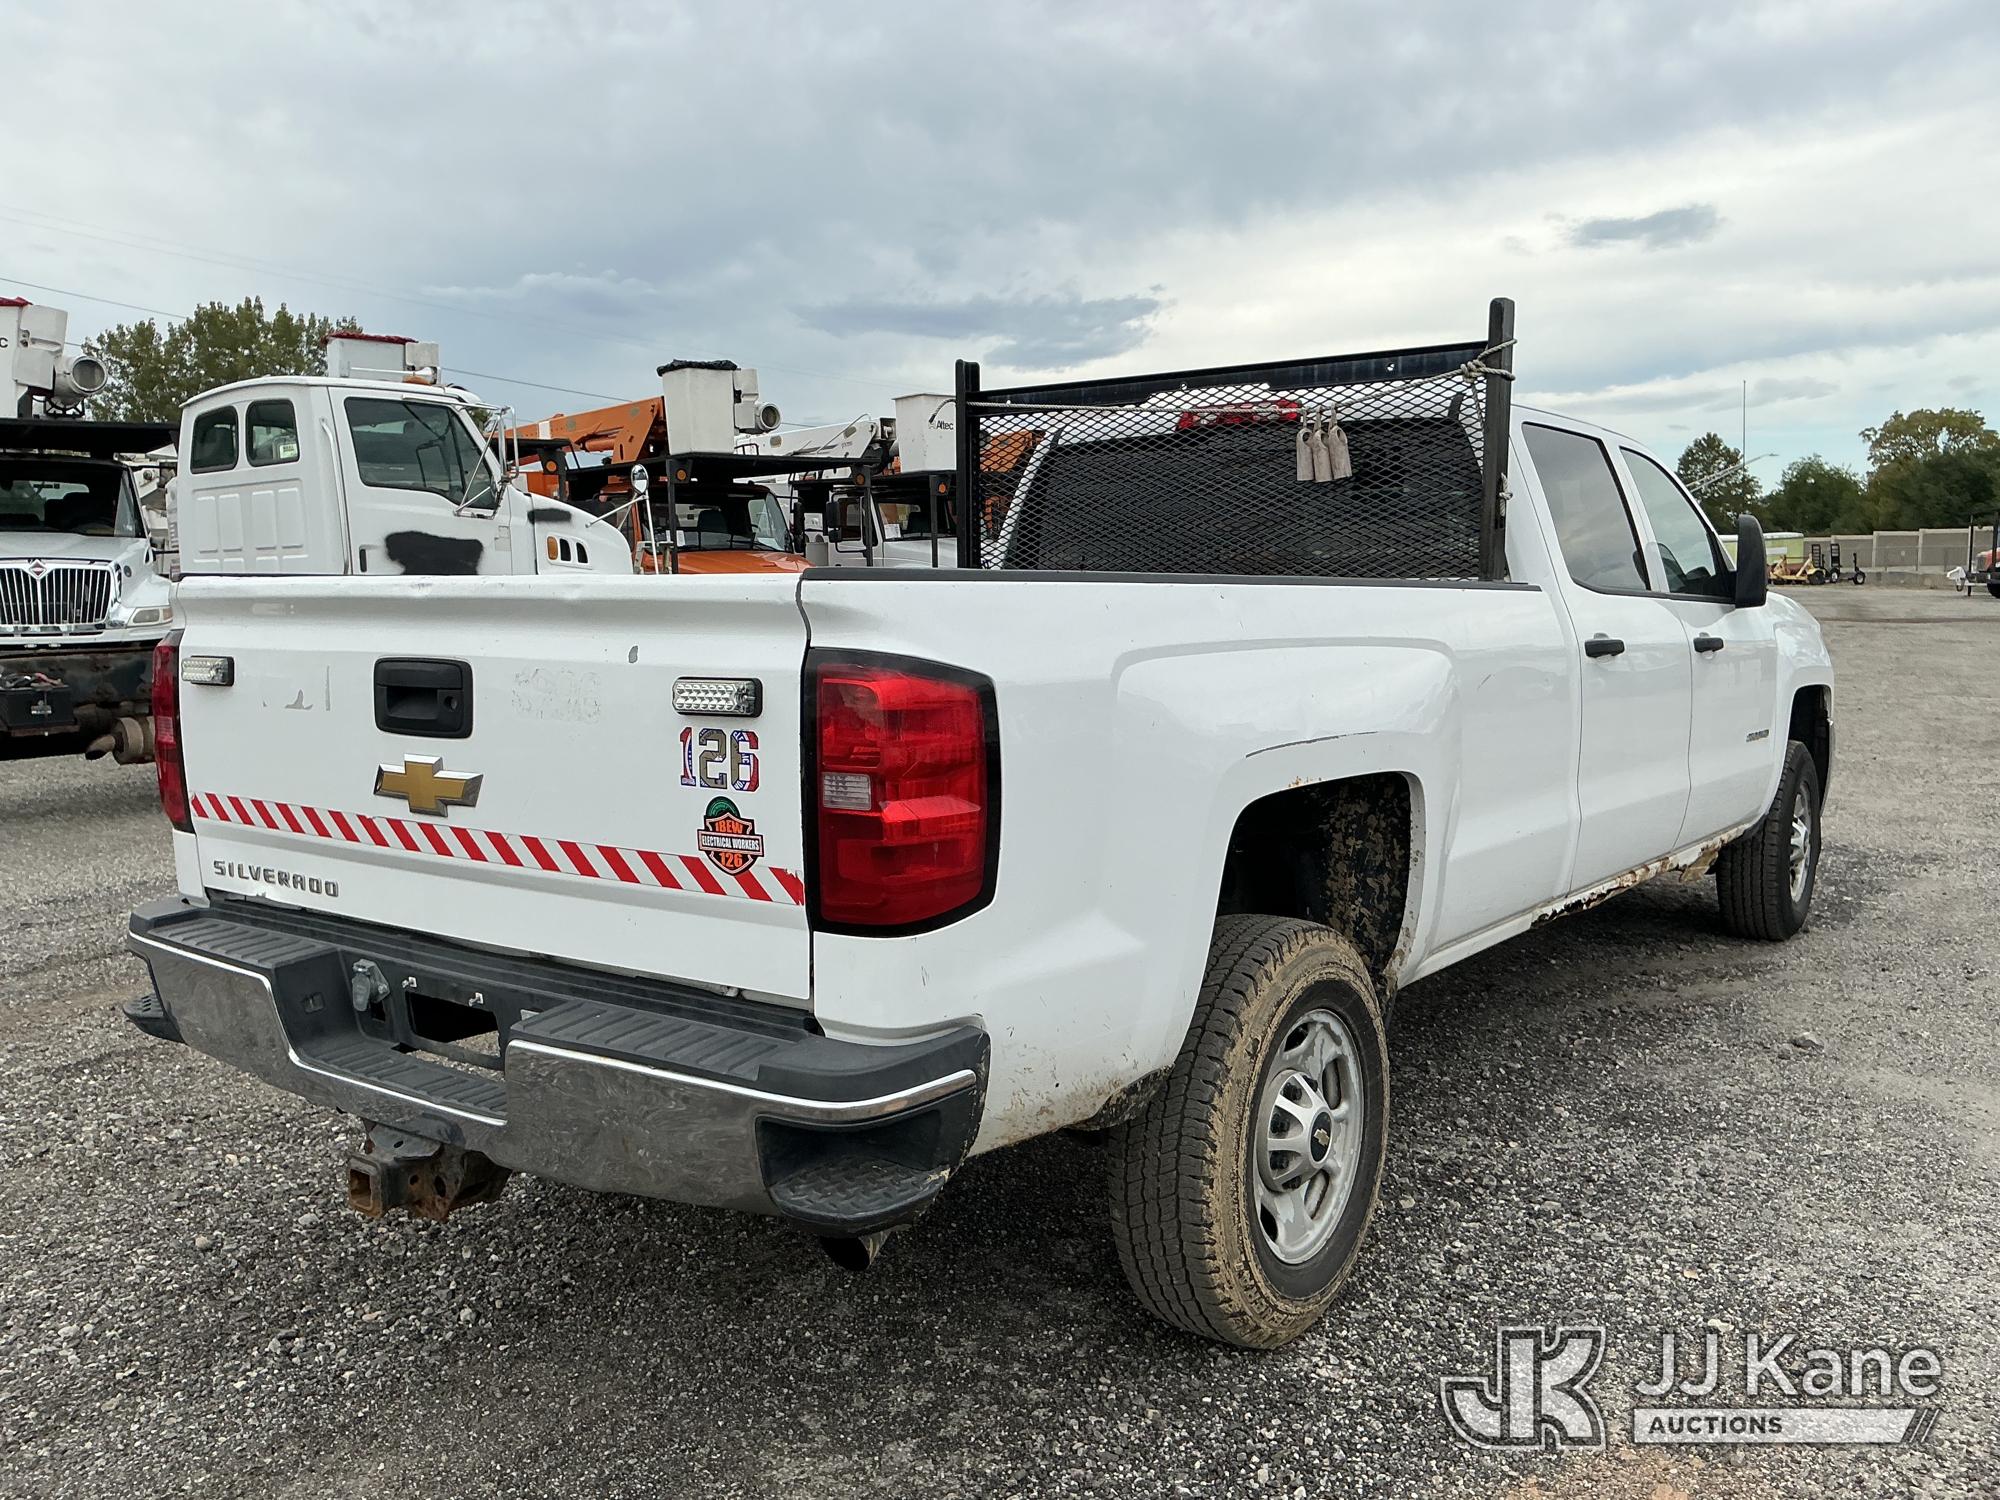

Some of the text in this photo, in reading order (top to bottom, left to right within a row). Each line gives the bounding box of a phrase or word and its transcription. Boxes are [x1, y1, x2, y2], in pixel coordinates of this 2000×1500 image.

[680, 726, 760, 792] 126
[715, 820, 743, 833] IBEW
[702, 835, 760, 851] ELECTRICAL WORKERS
[719, 852, 743, 868] 126
[213, 860, 339, 898] SILVERADO
